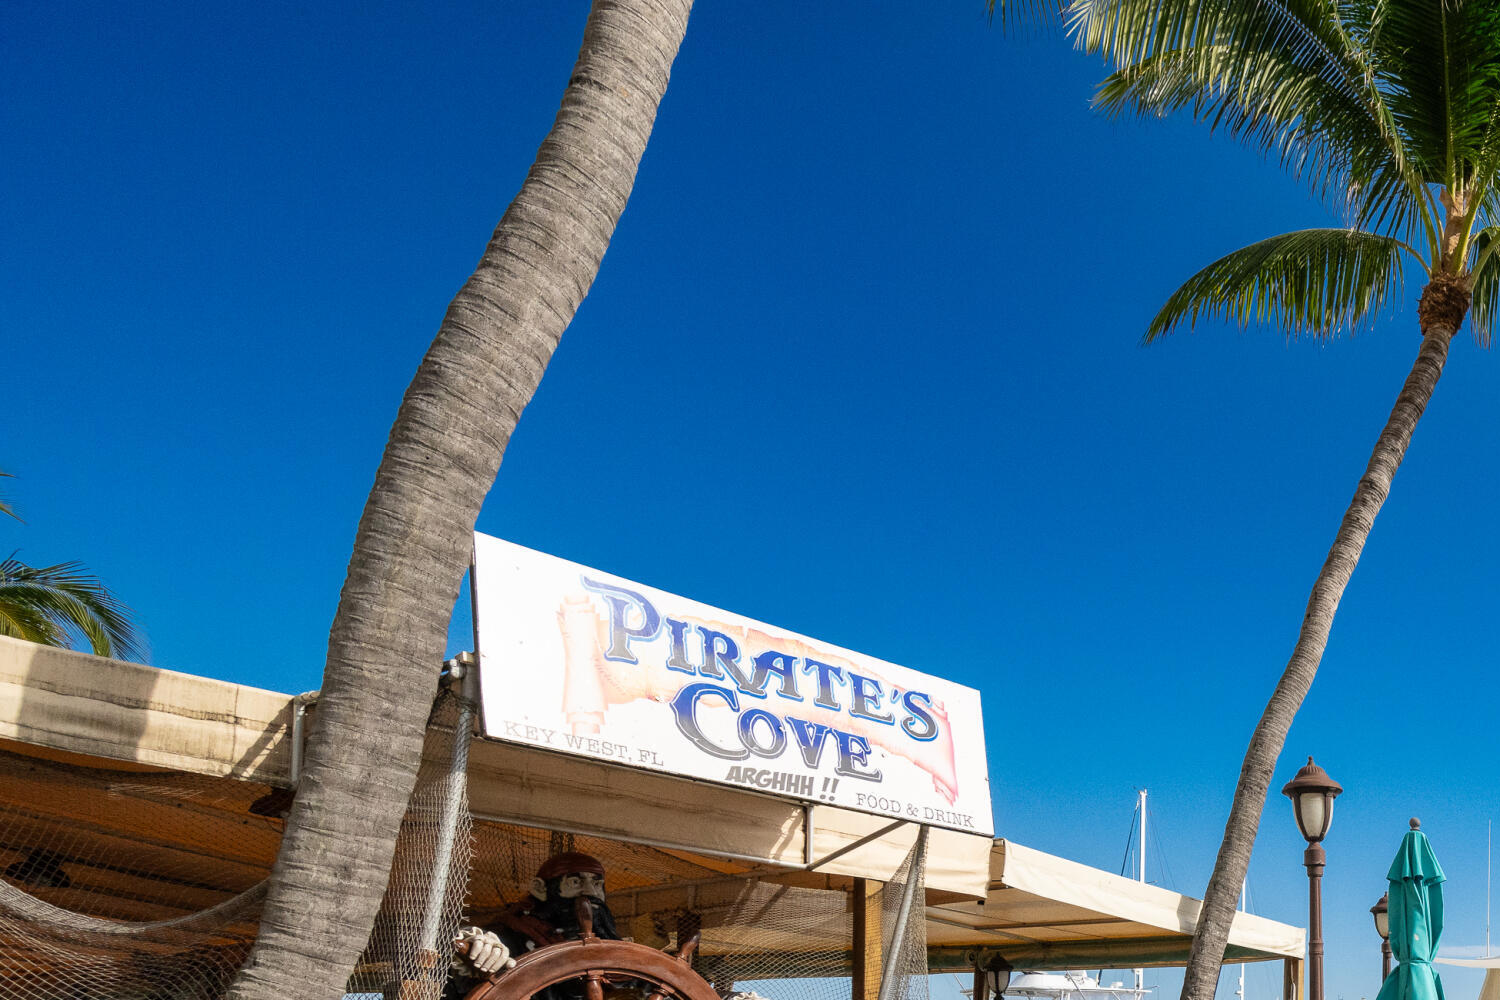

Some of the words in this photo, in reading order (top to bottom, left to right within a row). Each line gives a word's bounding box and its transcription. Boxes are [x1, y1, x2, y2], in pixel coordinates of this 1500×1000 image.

[581, 574, 938, 742] PIRATE'S
[504, 720, 558, 745] KEY
[562, 732, 633, 763] WEST,
[637, 748, 665, 767] FL
[669, 682, 883, 784] COVE
[724, 765, 815, 797] ARGHHH
[818, 776, 840, 801] !!
[855, 792, 902, 814] FOOD
[906, 802, 920, 818] &
[924, 806, 975, 829] DRINK
